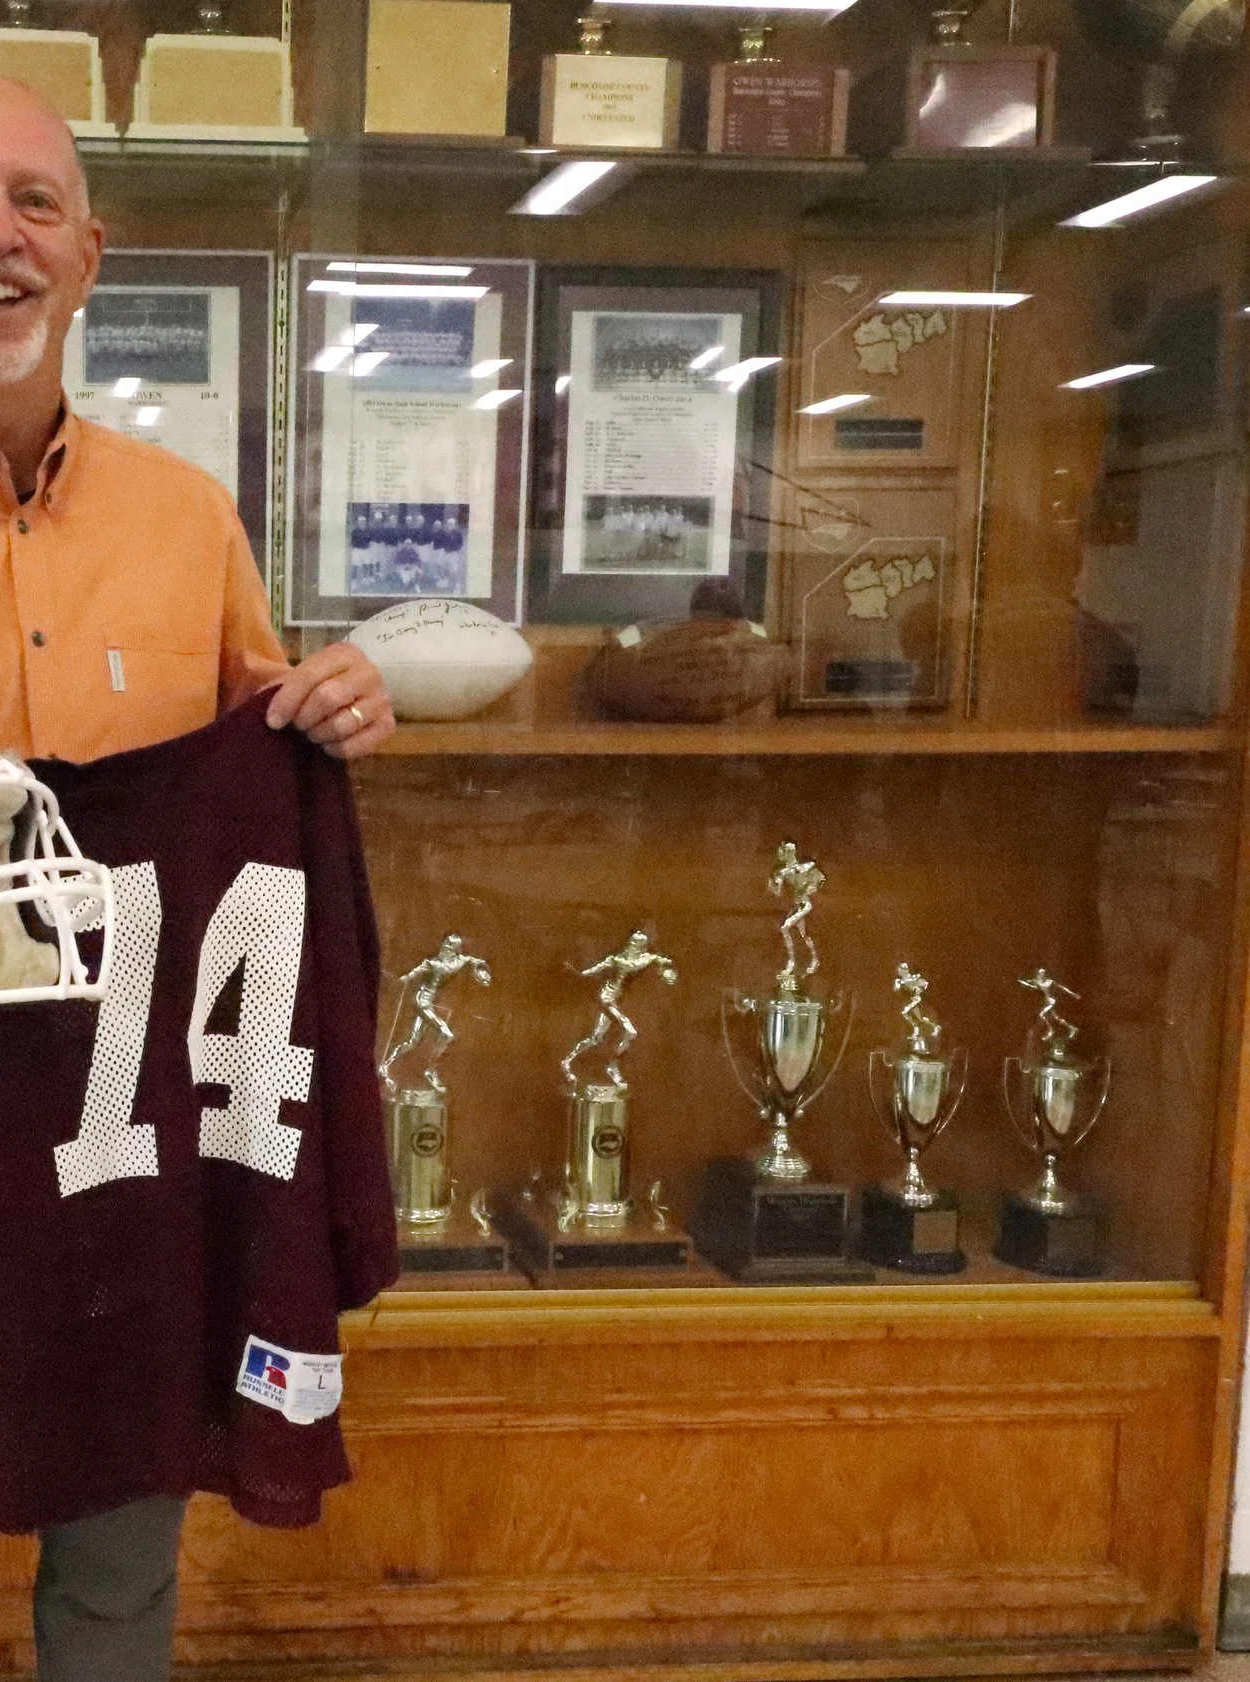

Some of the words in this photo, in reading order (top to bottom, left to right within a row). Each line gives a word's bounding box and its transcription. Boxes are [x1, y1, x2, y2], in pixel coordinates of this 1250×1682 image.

[75, 391, 95, 400] 1997
[317, 1374, 327, 1390] L
[241, 1382, 285, 1404] ATHLETIC
